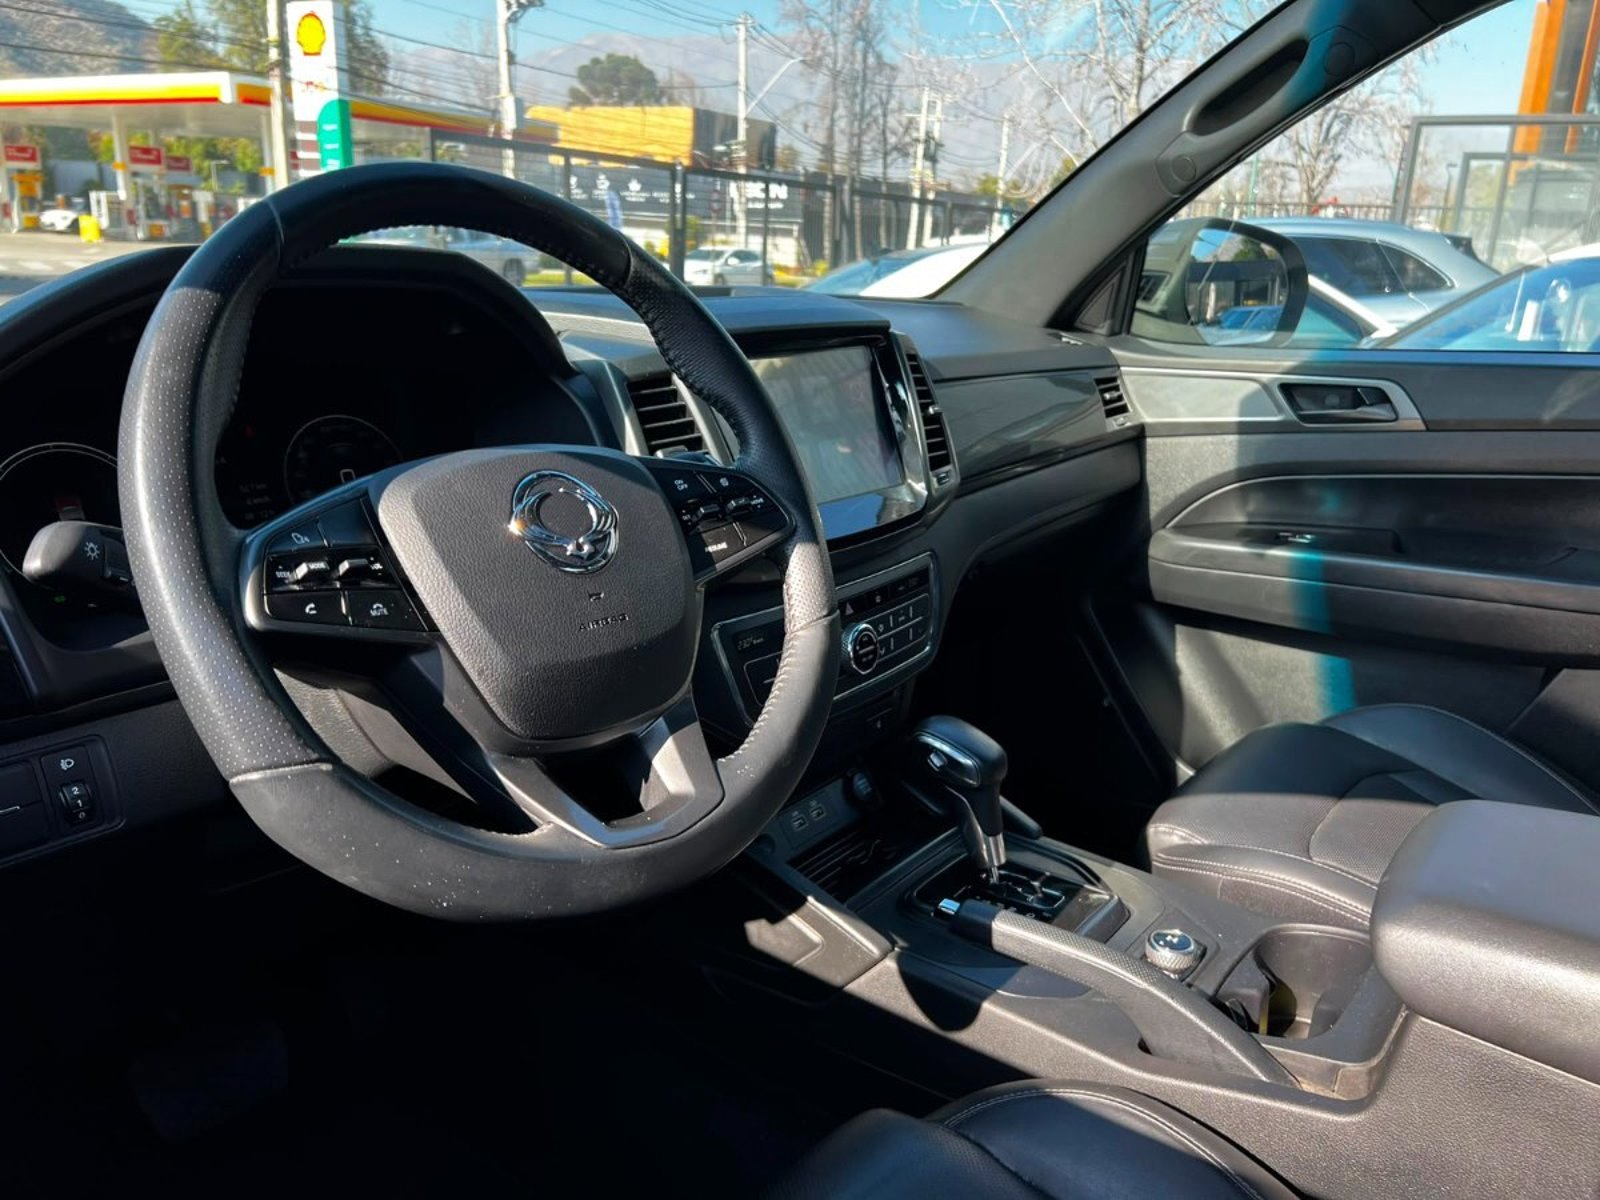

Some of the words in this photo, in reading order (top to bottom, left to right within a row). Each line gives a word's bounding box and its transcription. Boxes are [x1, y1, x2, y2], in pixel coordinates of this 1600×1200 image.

[579, 613, 629, 632] AIRBAG
[71, 786, 80, 795] 2
[76, 799, 83, 807] 1
